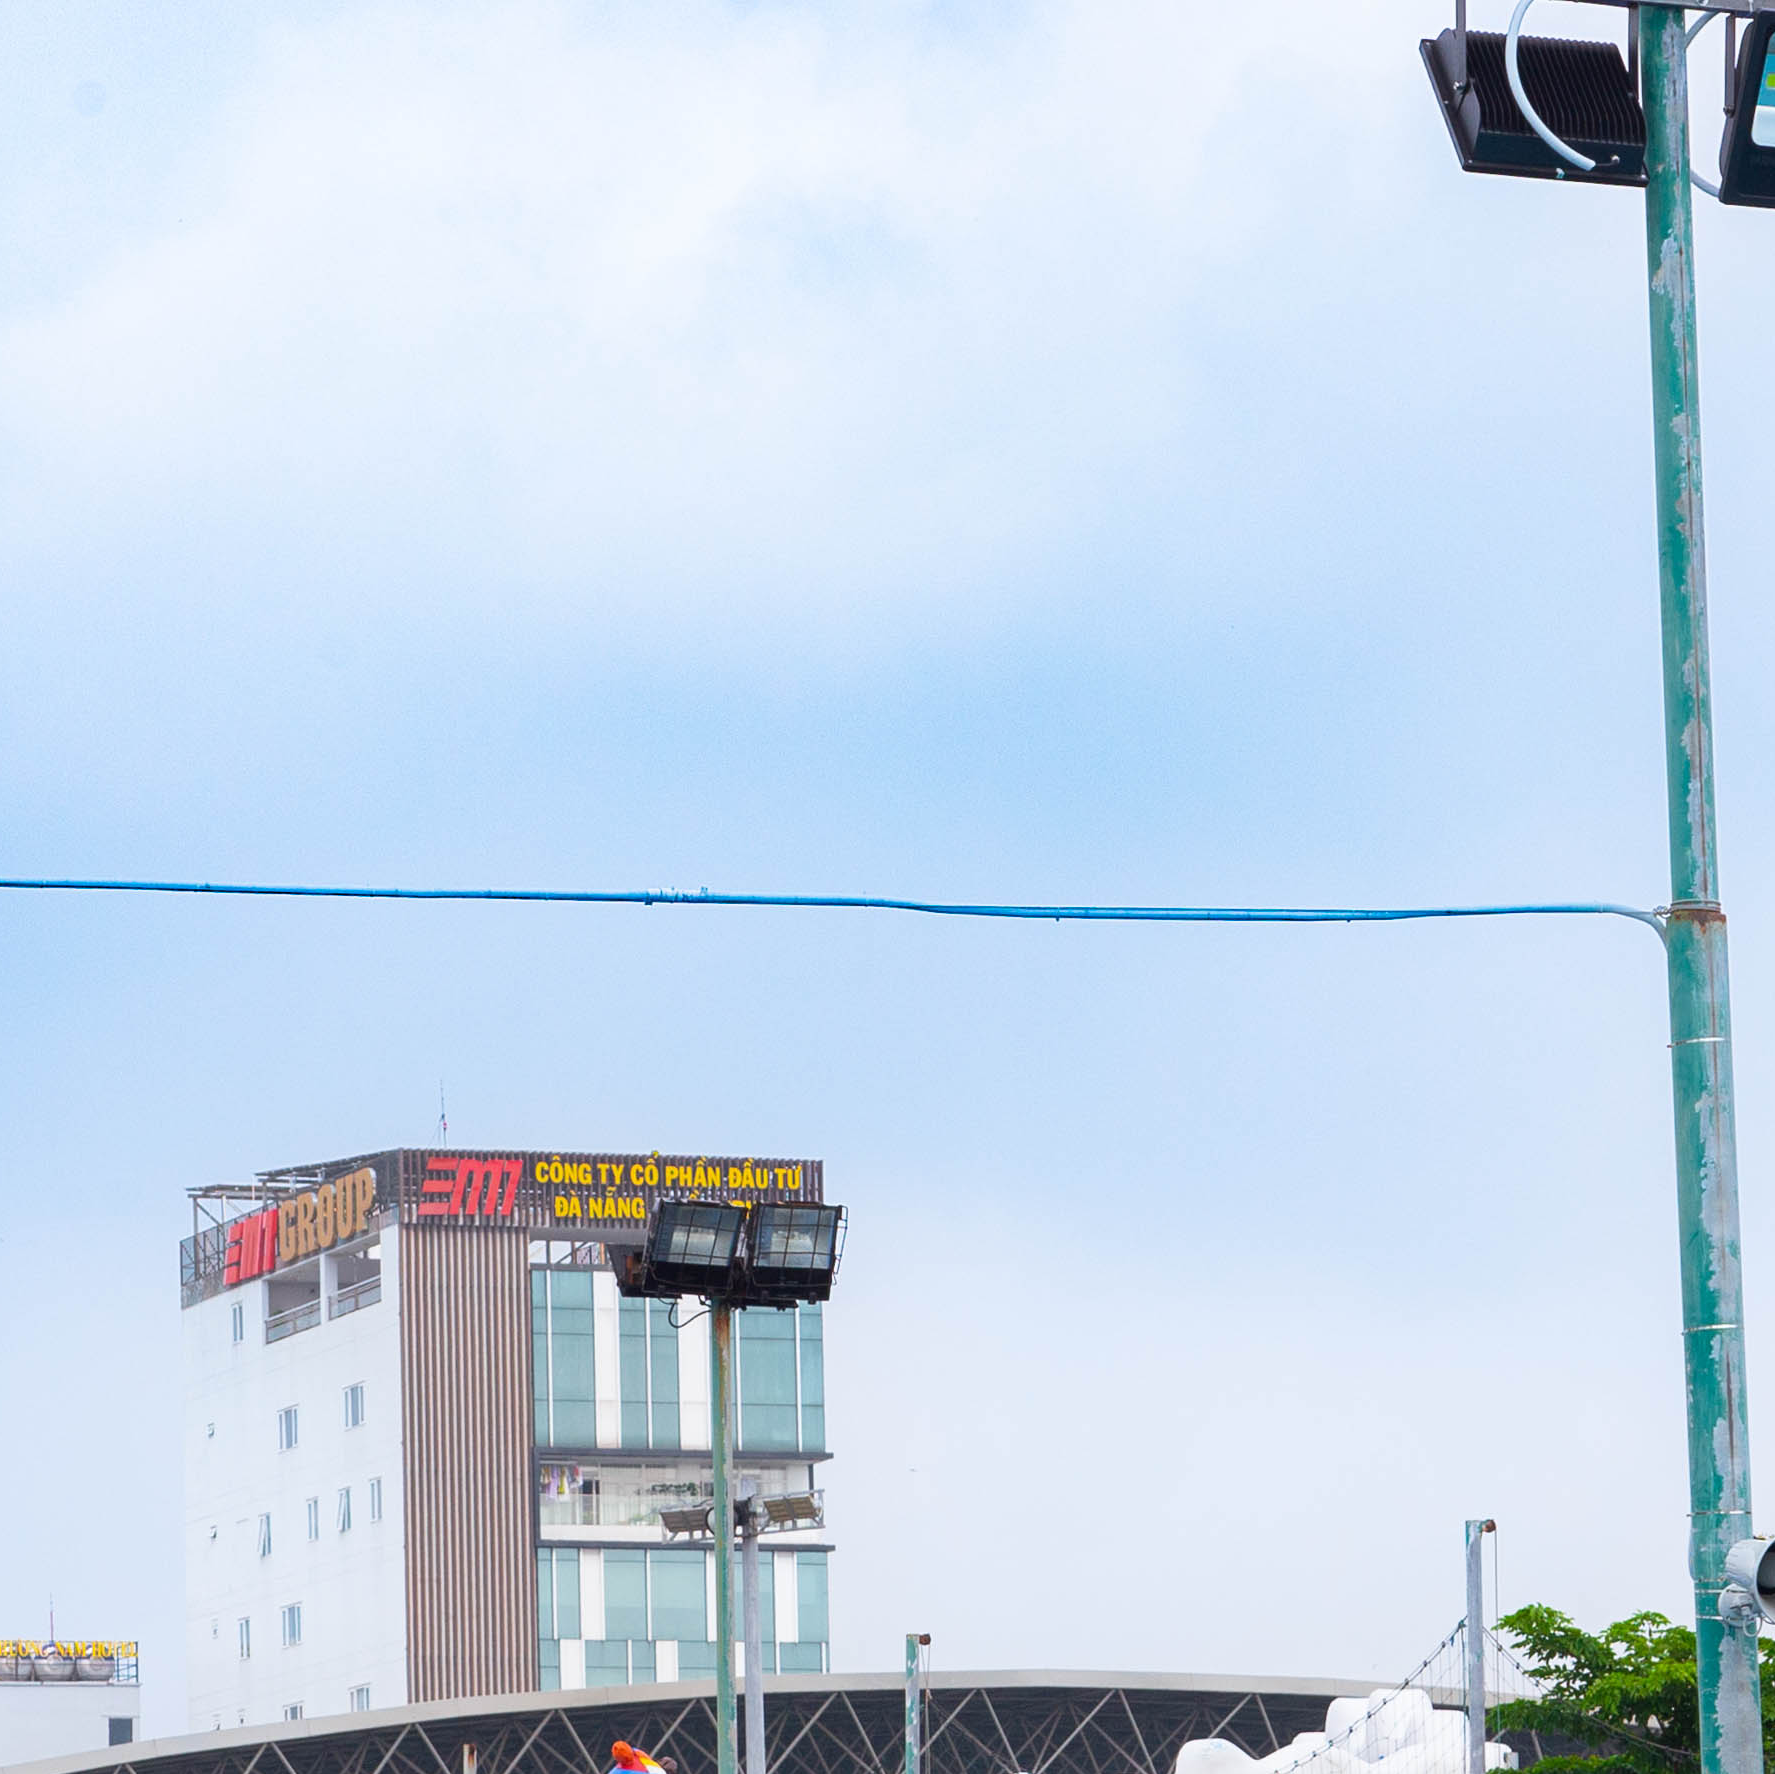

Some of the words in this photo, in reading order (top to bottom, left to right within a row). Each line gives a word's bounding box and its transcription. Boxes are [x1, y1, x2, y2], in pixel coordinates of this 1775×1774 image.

[534, 1155, 593, 1185] CÔNG
[597, 1163, 625, 1186] TY
[630, 1151, 660, 1187] CỔ
[665, 1156, 721, 1188] PHẦN
[728, 1158, 769, 1190] ĐẦU
[774, 1164, 803, 1191] TƯ
[278, 1167, 377, 1261] GROUP
[554, 1190, 582, 1218] ĐÀ
[588, 1186, 646, 1219] NẴNG
[55, 1641, 88, 1657] NAM
